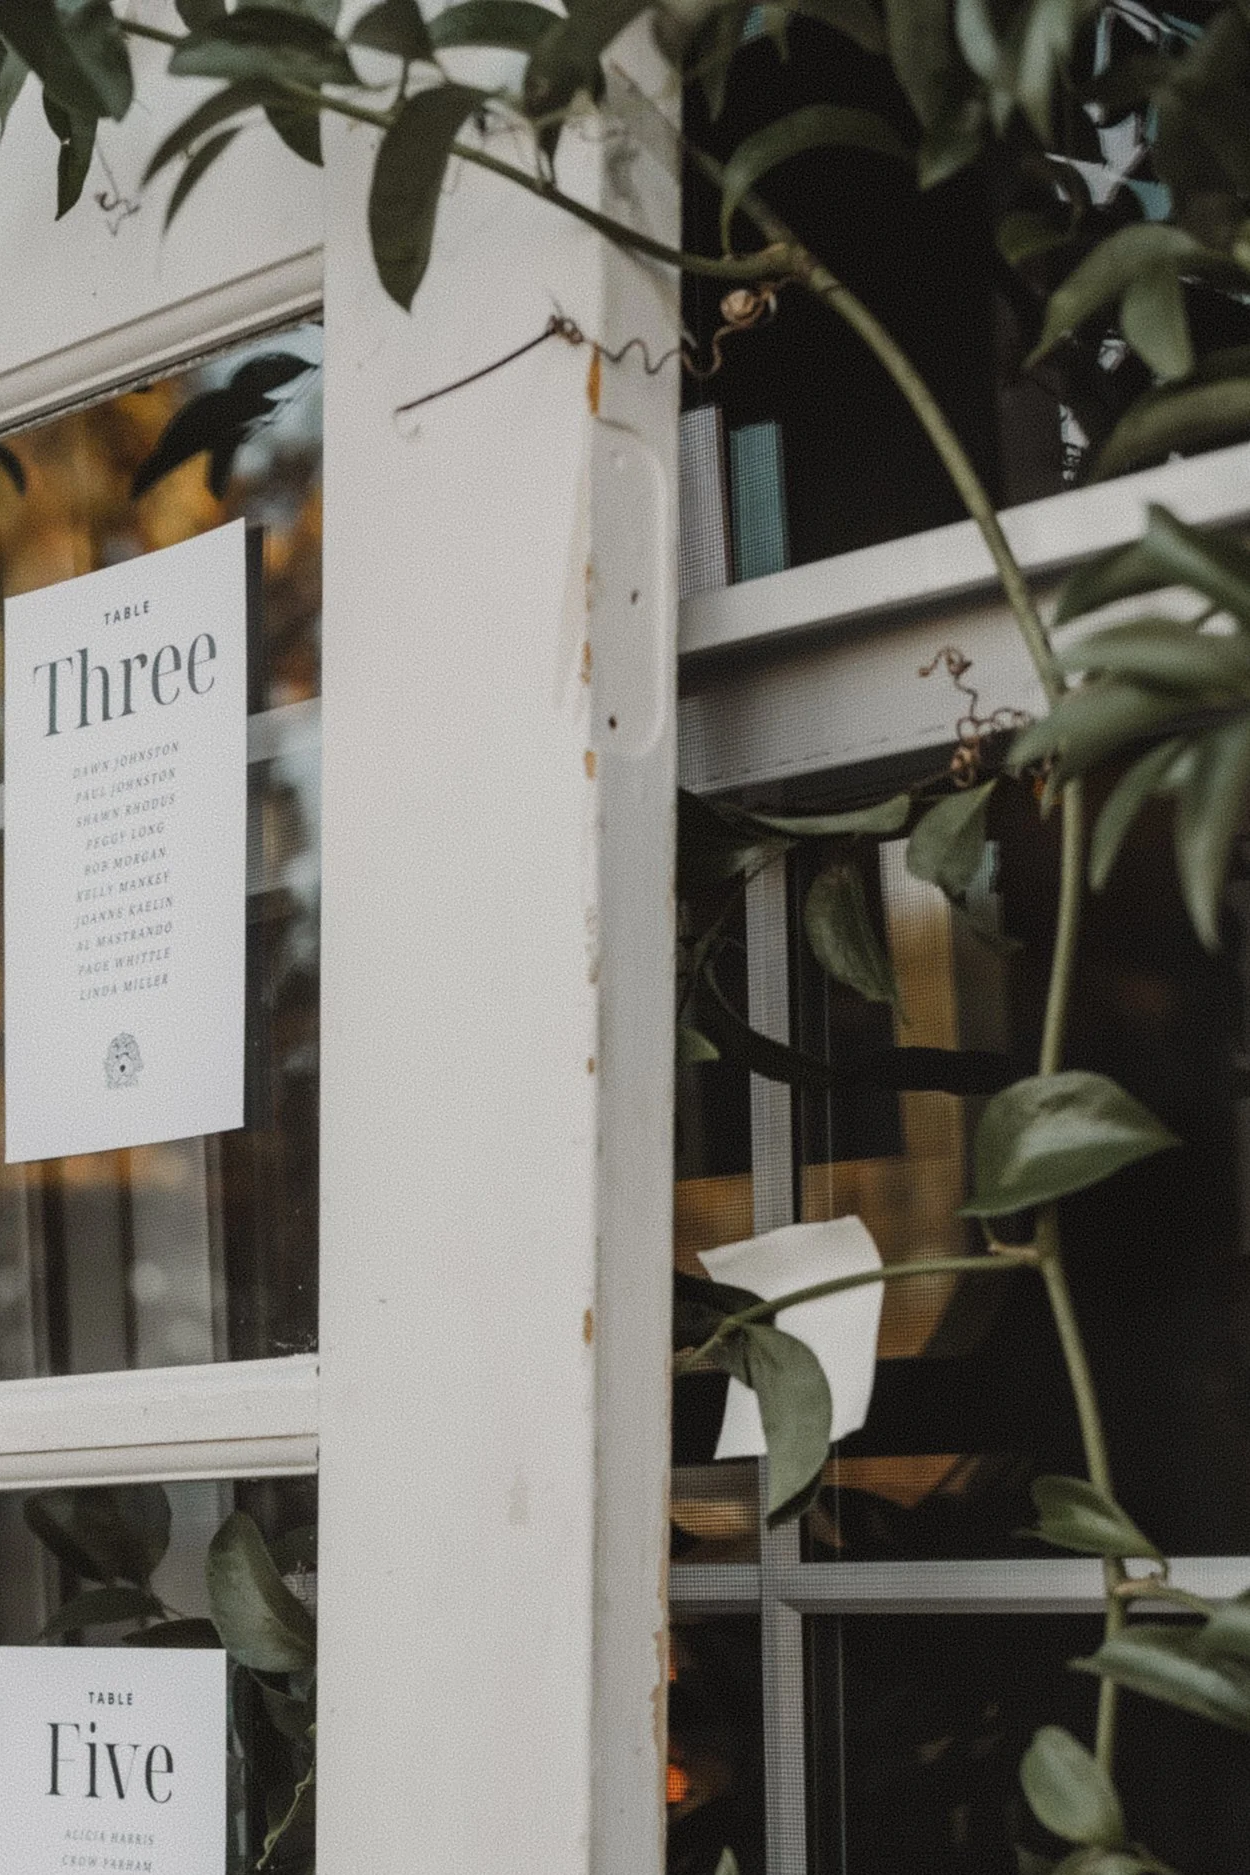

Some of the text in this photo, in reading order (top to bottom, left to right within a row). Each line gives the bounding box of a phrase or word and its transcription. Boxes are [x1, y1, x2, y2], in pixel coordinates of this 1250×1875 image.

[103, 599, 151, 627] TABLE
[33, 632, 218, 738] Three
[72, 742, 180, 779] DAWN JOHNSTON
[75, 767, 176, 804] PAUL JOHNSTON
[76, 807, 120, 828] SHAWN
[86, 822, 165, 850] PEGGY LONG
[84, 847, 167, 876] BOB MORGAN
[76, 885, 113, 902] KELLY
[74, 896, 174, 930] JOANNE KAELIN
[115, 947, 171, 969] WHITTLE
[80, 973, 169, 1001] LINDA MILLER
[88, 1691, 134, 1707] TABLE
[45, 1721, 174, 1804] Five
[65, 1829, 155, 1846] ALICIA HARRIS
